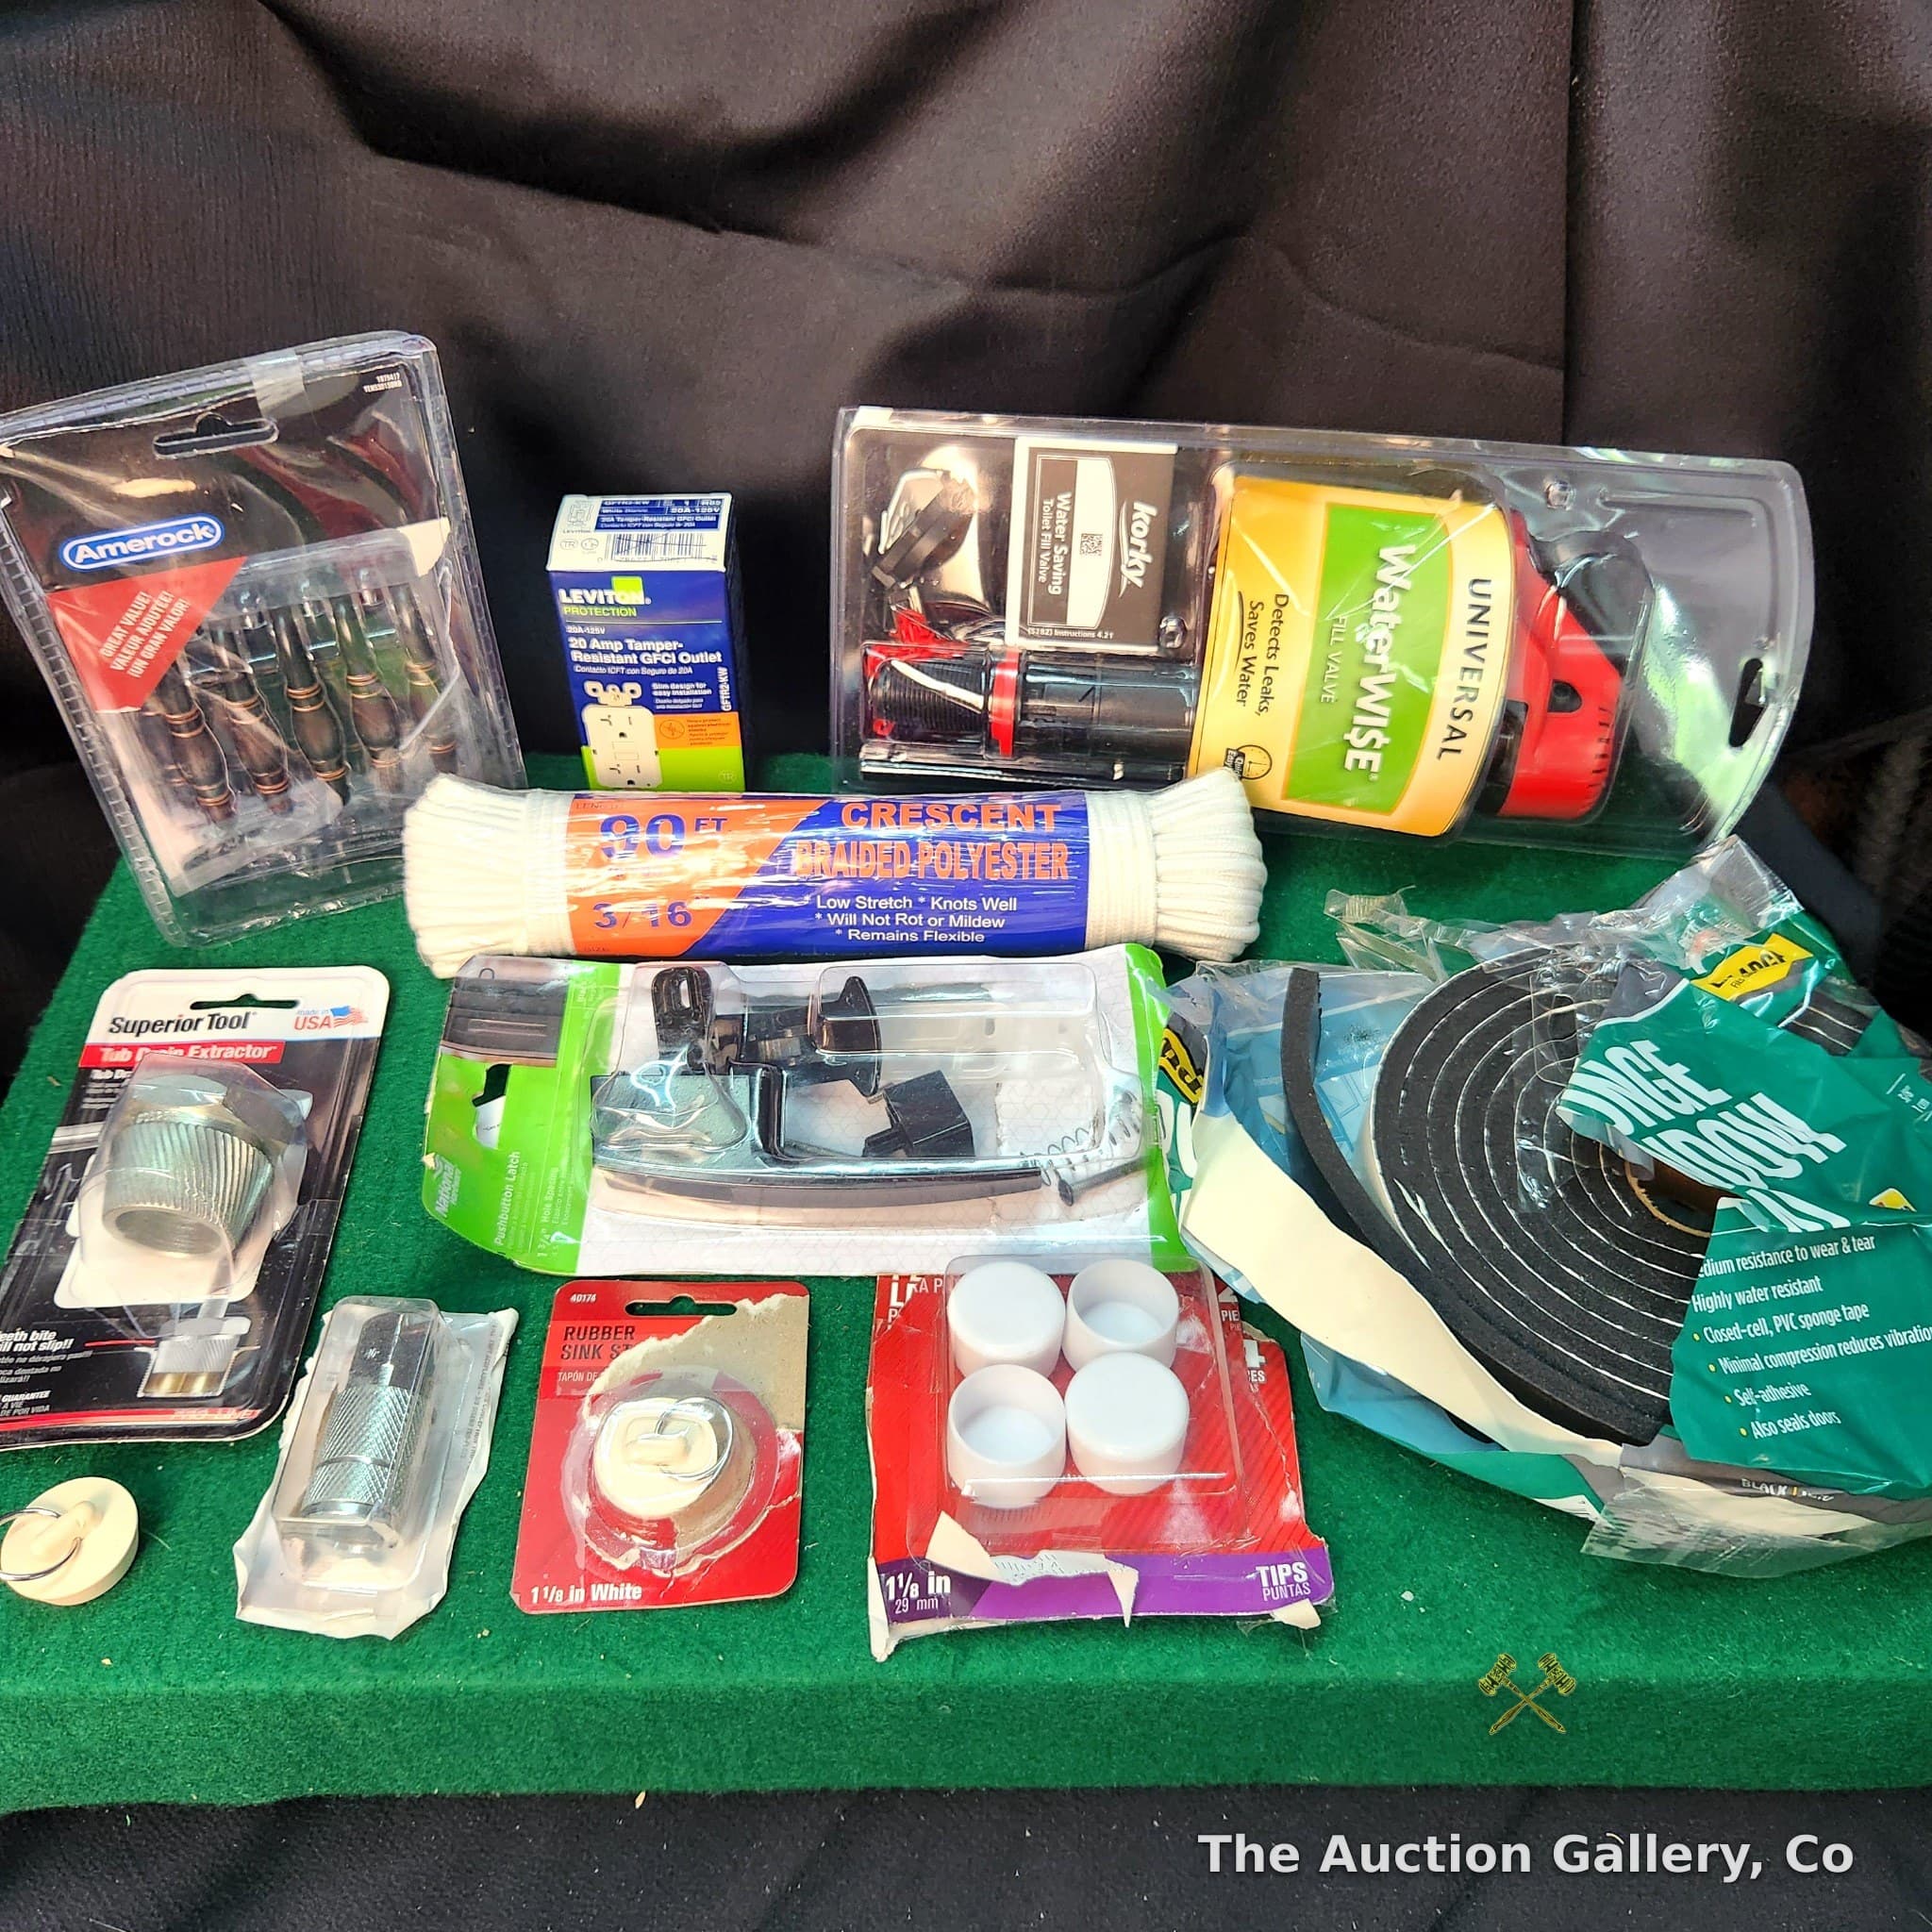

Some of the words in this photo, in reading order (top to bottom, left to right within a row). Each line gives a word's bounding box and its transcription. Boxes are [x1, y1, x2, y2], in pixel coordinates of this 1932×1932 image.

[1041, 498, 1055, 532] Toilet
[1053, 491, 1073, 542] Water
[75, 523, 216, 564] Amerock
[1040, 533, 1053, 550] Fill
[1038, 551, 1050, 584] Valve
[1046, 544, 1070, 595] Saving
[558, 588, 646, 606] LEVITON
[563, 606, 638, 618] PROTECTION
[98, 624, 130, 658] GREAT
[119, 590, 154, 628] VALUE!
[1243, 600, 1265, 651] Saves
[1266, 593, 1290, 660] Detects
[1329, 616, 1348, 646] FILL
[109, 634, 145, 672] VALEUR
[567, 637, 587, 650] 20
[590, 638, 624, 653] Amp
[625, 638, 684, 653] Tamper-
[571, 650, 639, 664] Resistant
[640, 652, 676, 665] GFCI
[677, 651, 723, 664] Outlet
[1236, 656, 1257, 707] Water
[1321, 650, 1342, 703] VALVE
[1436, 577, 1493, 761] UNIVERSAL
[1255, 664, 1280, 717] Leaks,
[841, 802, 1061, 833] CRESCENT
[600, 814, 686, 858] 90
[694, 817, 728, 832] FT
[794, 840, 912, 880] BRAIDED
[917, 841, 1070, 881] POLYESTER
[817, 895, 851, 910] Low
[855, 895, 913, 910] Stretch
[930, 896, 978, 911] Knots
[981, 897, 1018, 912] Well
[827, 913, 858, 926] Will
[862, 913, 891, 927] Not
[896, 913, 924, 927] Rot
[927, 916, 944, 927] or
[949, 914, 1007, 929] Mildew
[848, 928, 920, 942] Remains
[924, 929, 986, 943] Flexible
[108, 1013, 202, 1038] Superior
[208, 1011, 253, 1030] Tool
[293, 1015, 332, 1031] USA
[99, 1047, 133, 1063] Tub
[189, 1043, 272, 1059] Extractor
[494, 1181, 515, 1246] Pushbutton
[506, 1151, 521, 1181] Latch
[1736, 1247, 1794, 1272] resistance
[1794, 1244, 1809, 1262] to
[1809, 1241, 1840, 1259] wear
[1840, 1237, 1852, 1254] &
[1851, 1236, 1876, 1252] tear
[1690, 1290, 1733, 1314] Highly
[1734, 1286, 1770, 1306] water
[1771, 1275, 1824, 1300] resistant
[0, 1329, 29, 1341] eeth
[29, 1330, 58, 1341] bite
[563, 1325, 636, 1341] RUBBER
[1703, 1317, 1774, 1344] Closed-cell,
[1772, 1312, 1799, 1334] PVC
[1798, 1307, 1843, 1330] sponge
[1841, 1304, 1870, 1323] tape
[0, 1341, 14, 1352] ill
[13, 1341, 39, 1352] not
[38, 1339, 75, 1353] slip!!
[560, 1343, 605, 1360] SINK
[1718, 1352, 1765, 1374] Minimal
[1763, 1341, 1838, 1369] compression
[1838, 1336, 1886, 1357] reduces
[558, 1370, 586, 1382] TAPÓN
[1733, 1382, 1812, 1407] Self-adhesive
[1750, 1420, 1779, 1441] Also
[1776, 1413, 1810, 1434] seals
[1807, 1409, 1841, 1427] doors
[927, 1571, 951, 1596] in
[1255, 1561, 1308, 1588] TIPS
[569, 1585, 586, 1603] in
[591, 1583, 642, 1602] White
[894, 1598, 909, 1614] 29
[916, 1596, 939, 1611] mm
[1262, 1582, 1312, 1602] PUNTAS
